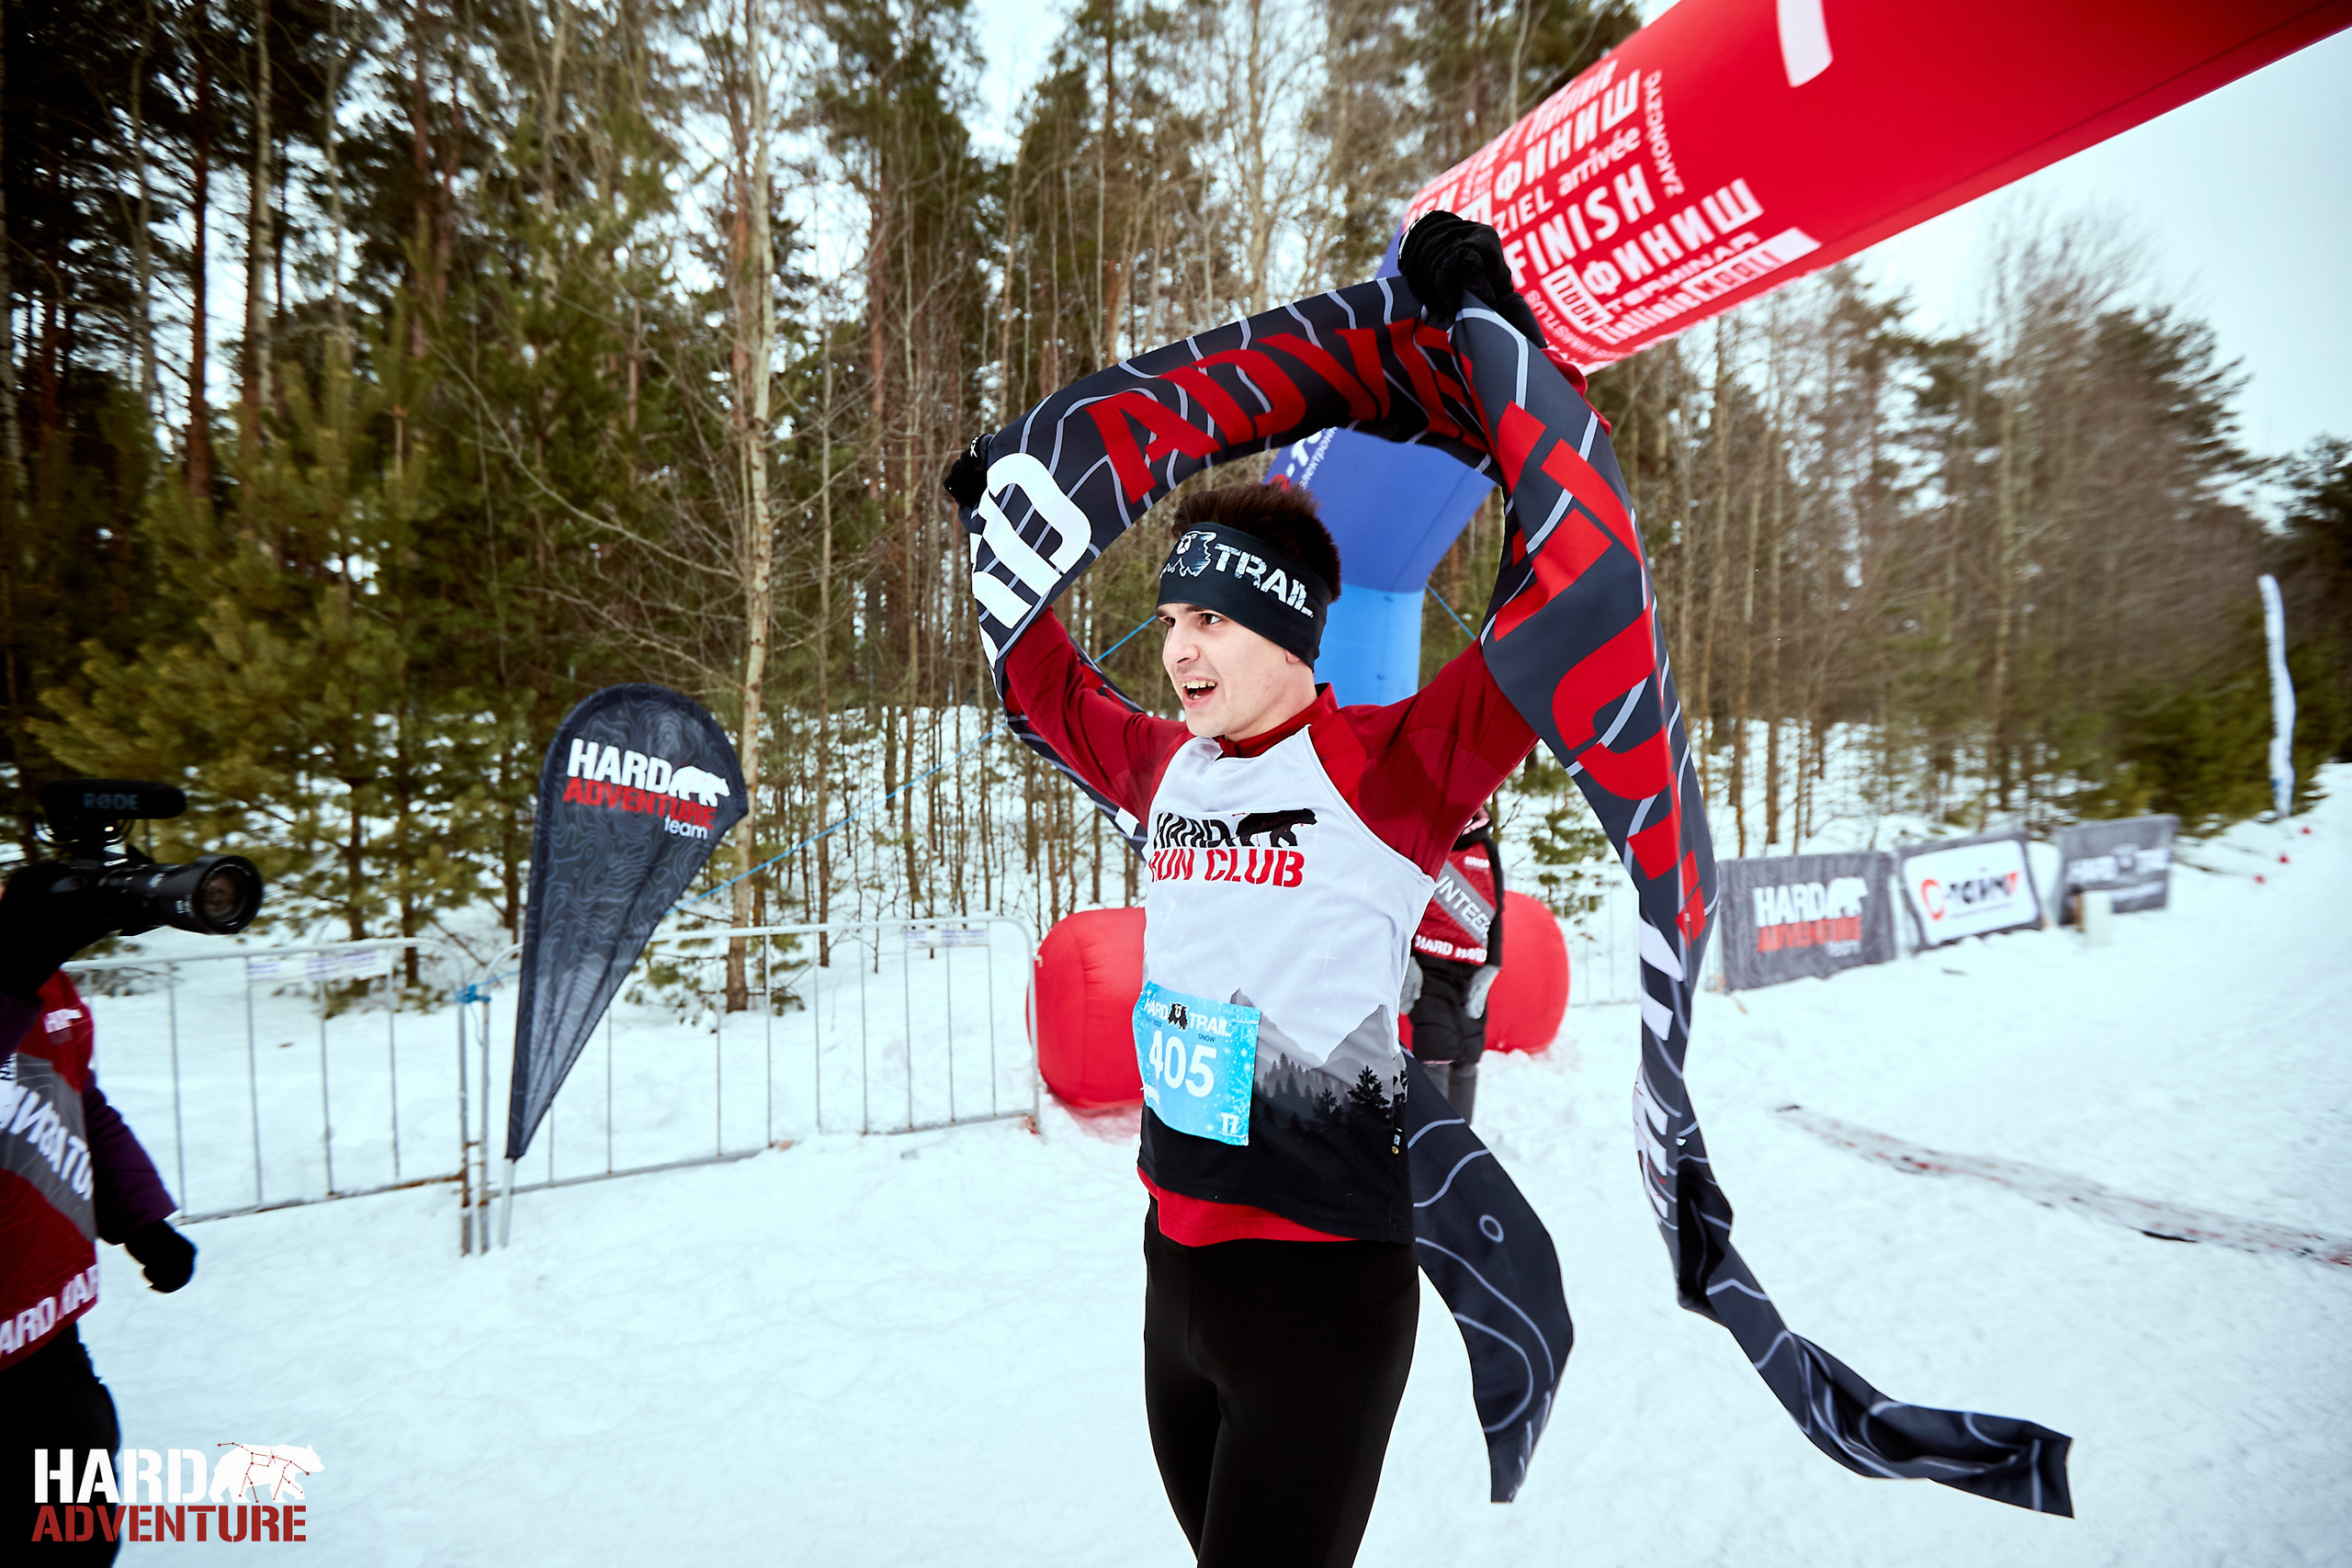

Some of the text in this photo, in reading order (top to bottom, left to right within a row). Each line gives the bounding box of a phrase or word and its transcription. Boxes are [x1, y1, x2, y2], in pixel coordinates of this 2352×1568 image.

[1494, 69, 1641, 201] ФИНИШ
[1492, 186, 1555, 240] ZIEL
[1558, 127, 1641, 197] arrivée
[1502, 163, 1656, 289] FINISH
[1582, 177, 1764, 296] ФИНИШ
[1604, 231, 1759, 313] TERMINAR
[1215, 543, 1314, 617] TRAIL
[567, 739, 673, 795] HARD
[563, 777, 717, 830] ADVENTURE
[664, 815, 708, 840] team
[1153, 812, 1231, 850] HARD
[1148, 848, 1305, 888] RUN CLUB
[1753, 881, 1826, 928] HARD
[1415, 934, 1453, 956] HARD
[1143, 998, 1169, 1021] HARD
[1189, 1012, 1233, 1038] TRAIL
[1148, 1030, 1217, 1098] 405
[0, 1296, 57, 1359] ARD
